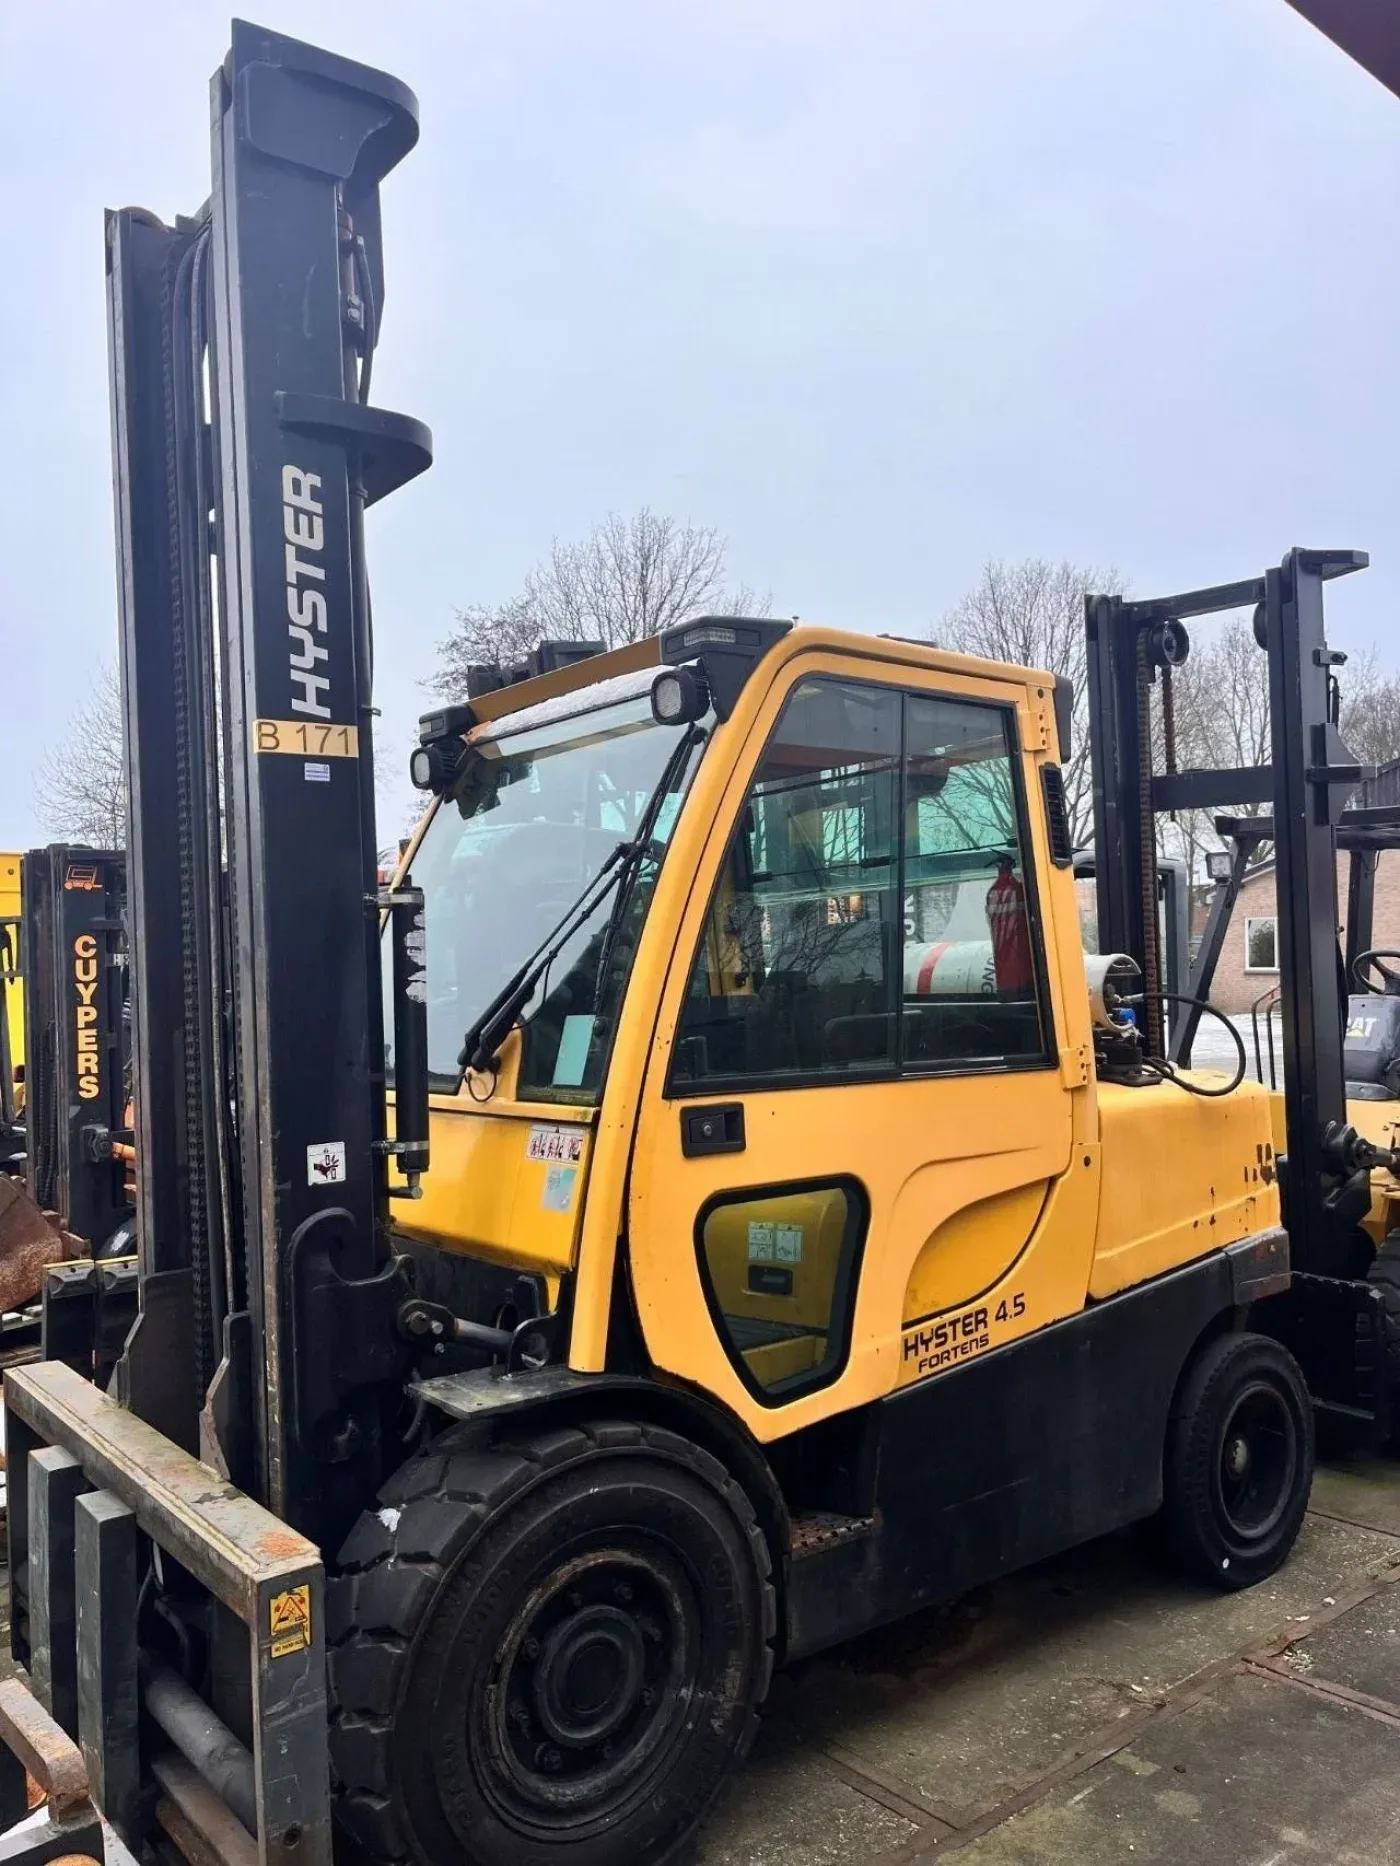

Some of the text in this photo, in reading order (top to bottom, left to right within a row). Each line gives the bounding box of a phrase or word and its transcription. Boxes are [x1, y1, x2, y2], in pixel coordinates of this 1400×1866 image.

[282, 464, 331, 718] HYSTER
[257, 721, 349, 755] B 171
[75, 935, 99, 1099] CUYPERS
[904, 1292, 1025, 1361] HYSTER 4.5
[919, 1333, 989, 1373] FORTENS
